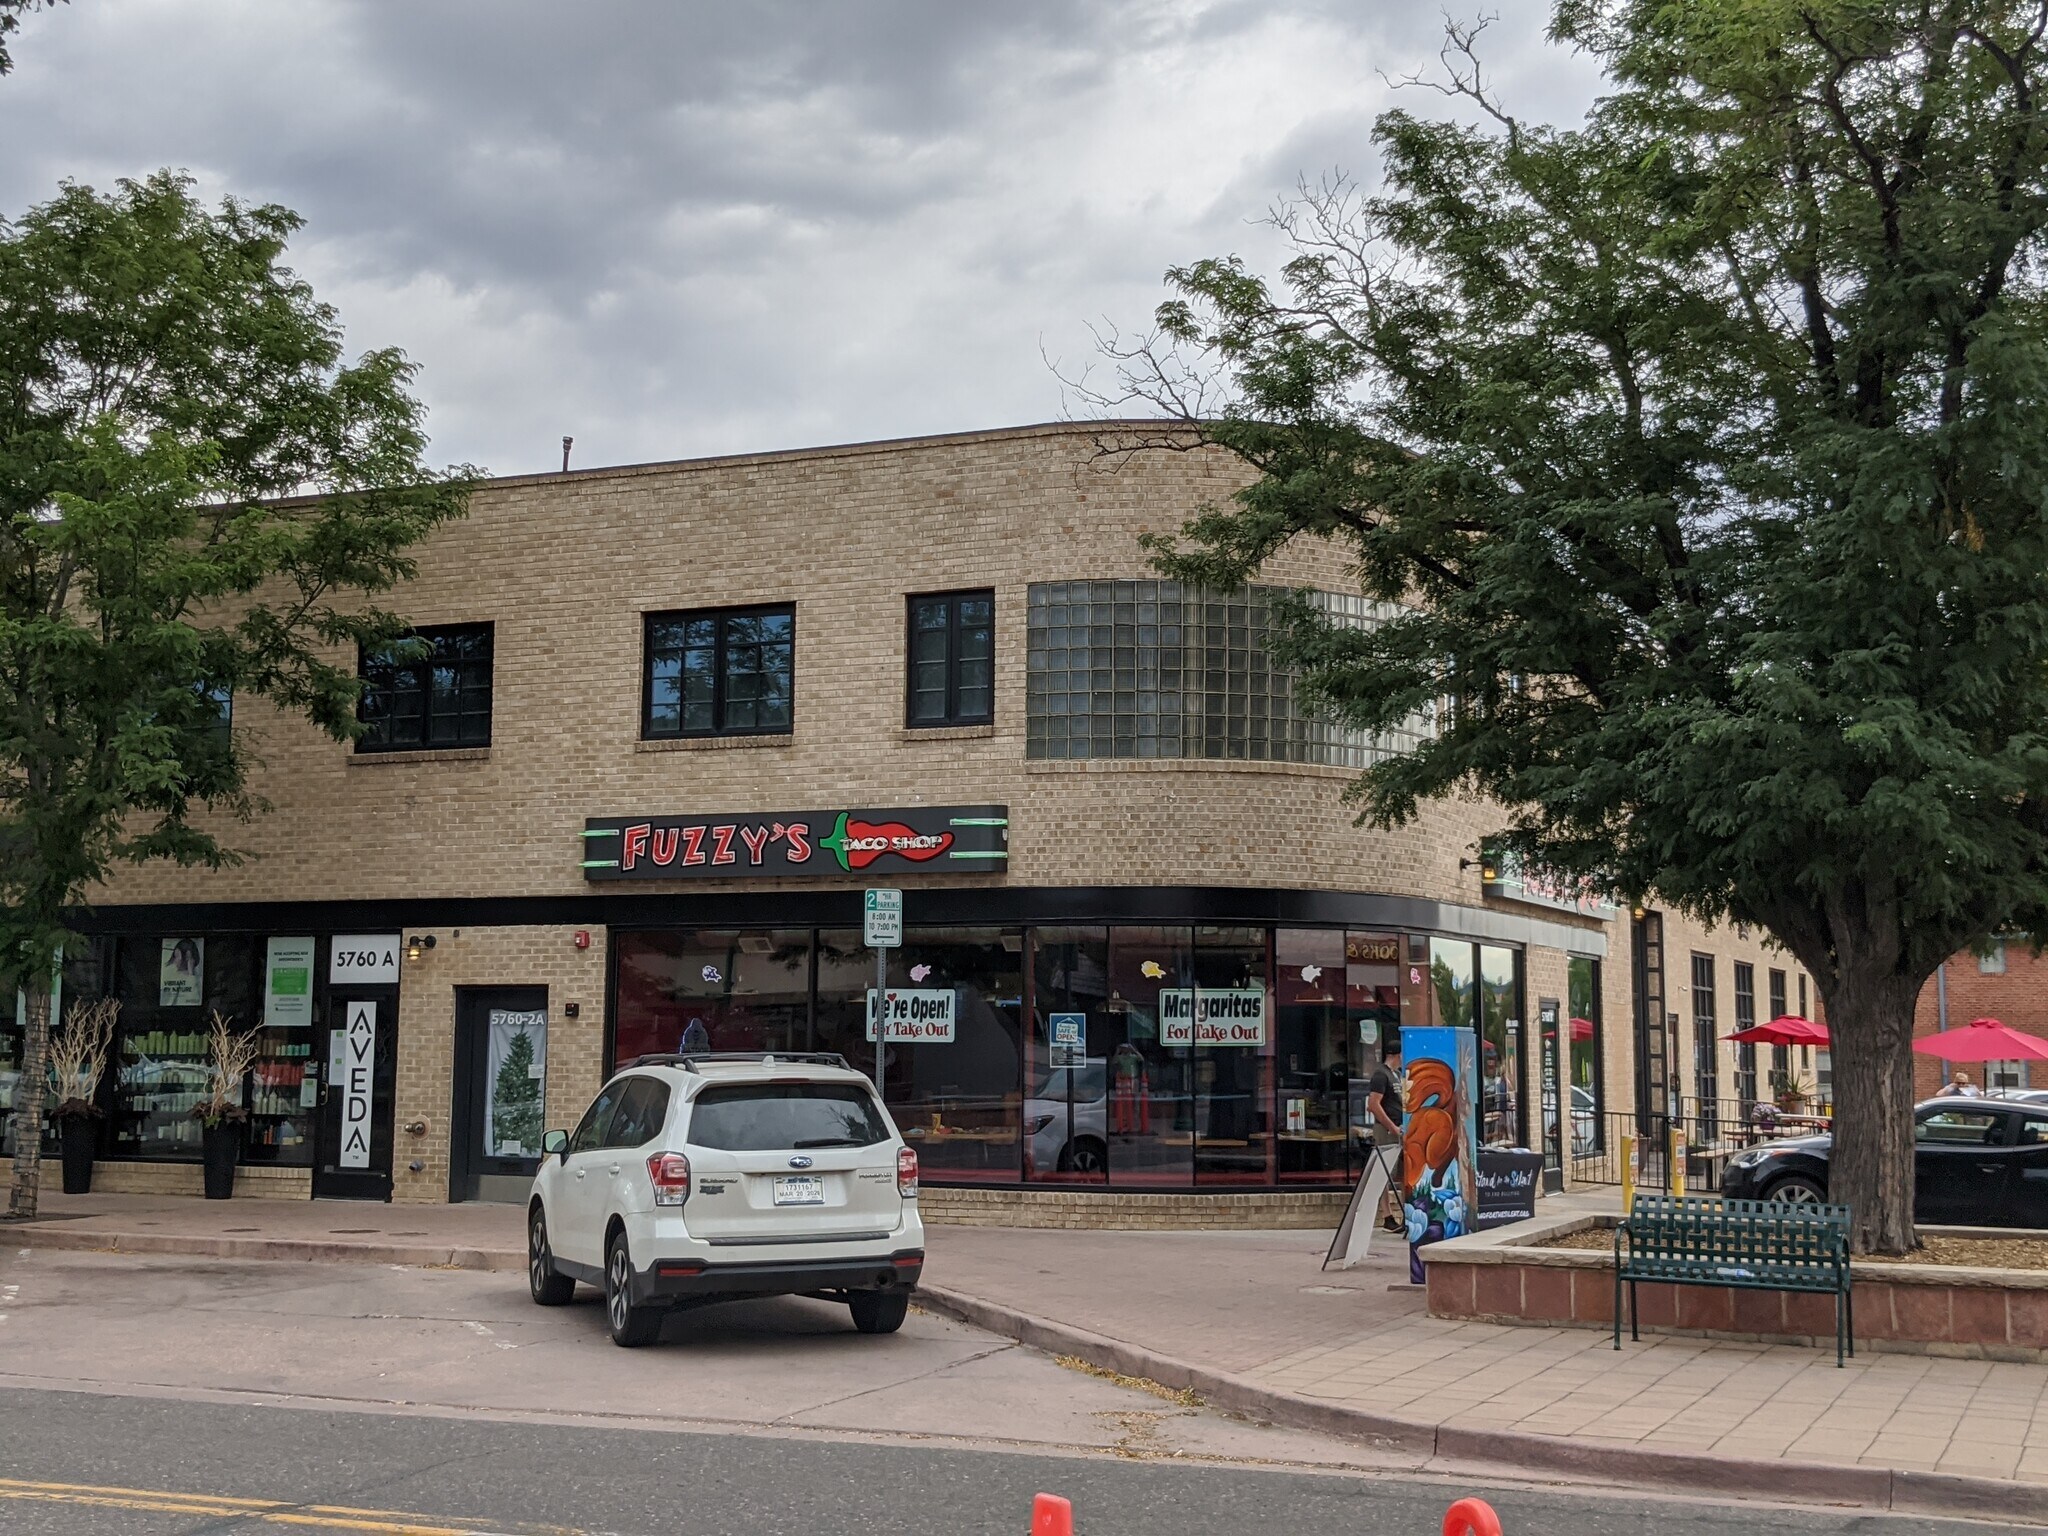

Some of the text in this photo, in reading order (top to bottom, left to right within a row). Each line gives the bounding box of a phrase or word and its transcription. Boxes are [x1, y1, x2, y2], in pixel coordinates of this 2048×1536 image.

[622, 823, 811, 871] FUZZY'S
[840, 836, 943, 851] TACO SHOP
[867, 892, 876, 908] 2
[877, 901, 900, 909] PARKING
[871, 912, 896, 921] 8:00 AM
[868, 922, 899, 931] TO 7:00 PM
[337, 950, 394, 967] 5760 A
[911, 995, 950, 1023] Open!
[1164, 993, 1261, 1022] Margaritas
[491, 1013, 545, 1025] 5760-2A
[893, 1021, 923, 1038] Take
[925, 1022, 949, 1036] Out
[1166, 1023, 1259, 1042] for Take Out
[345, 1008, 373, 1153] AVEDA
